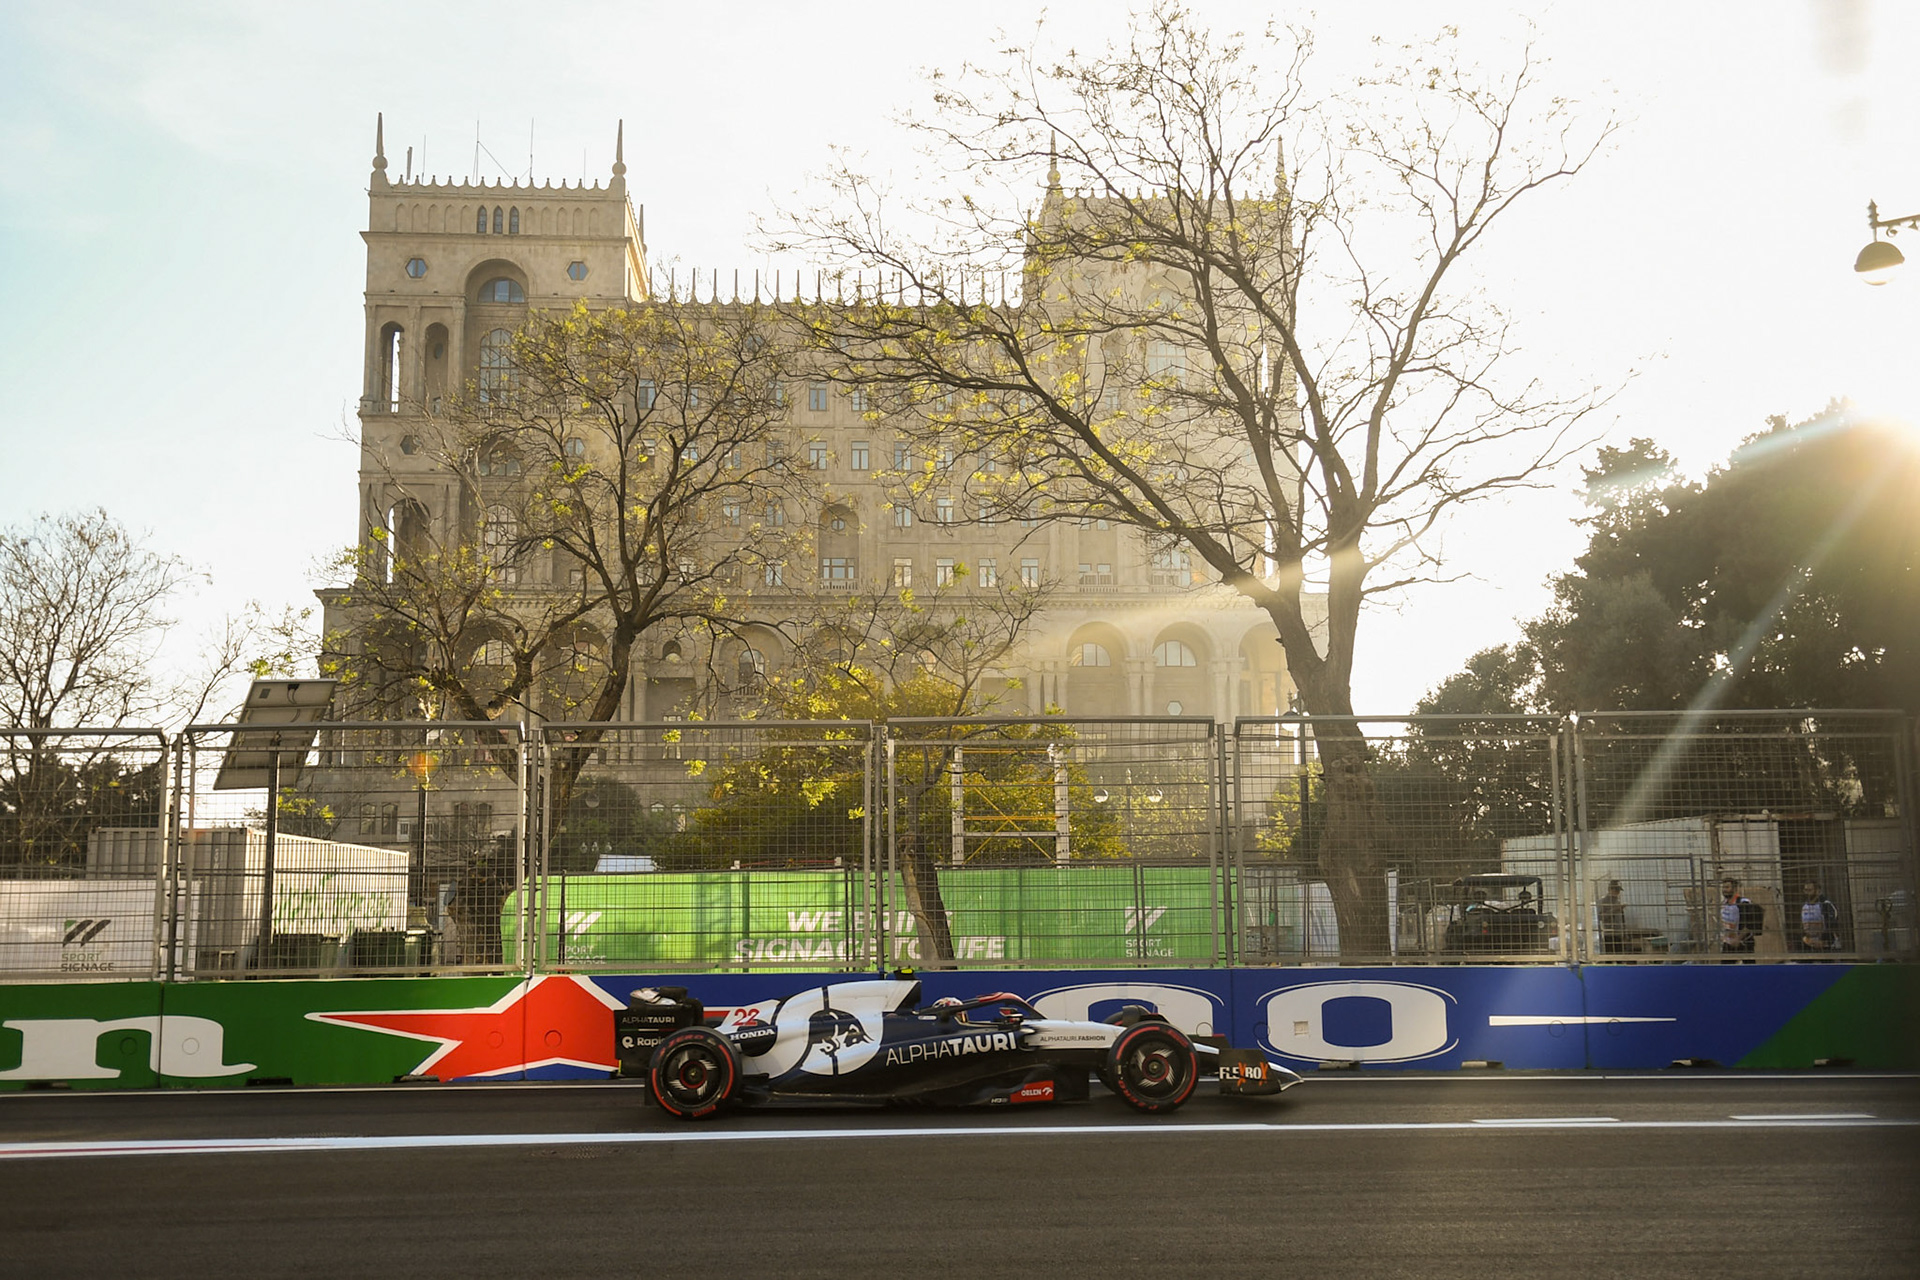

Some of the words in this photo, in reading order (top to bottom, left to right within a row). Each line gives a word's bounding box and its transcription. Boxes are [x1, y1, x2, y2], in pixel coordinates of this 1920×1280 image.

[788, 911, 842, 932] WE
[564, 945, 594, 955] PORT
[956, 937, 1006, 959] IFE
[61, 952, 101, 962] SPORT
[564, 955, 607, 965] IGNAGE
[61, 962, 114, 972] SIGNAGE
[621, 1016, 676, 1024] ALPHATAURI
[732, 1008, 760, 1027] 22
[730, 1028, 776, 1041] HONDA
[886, 1032, 1017, 1067] ALPHATAURI
[1020, 1088, 1042, 1097] ORLEN
